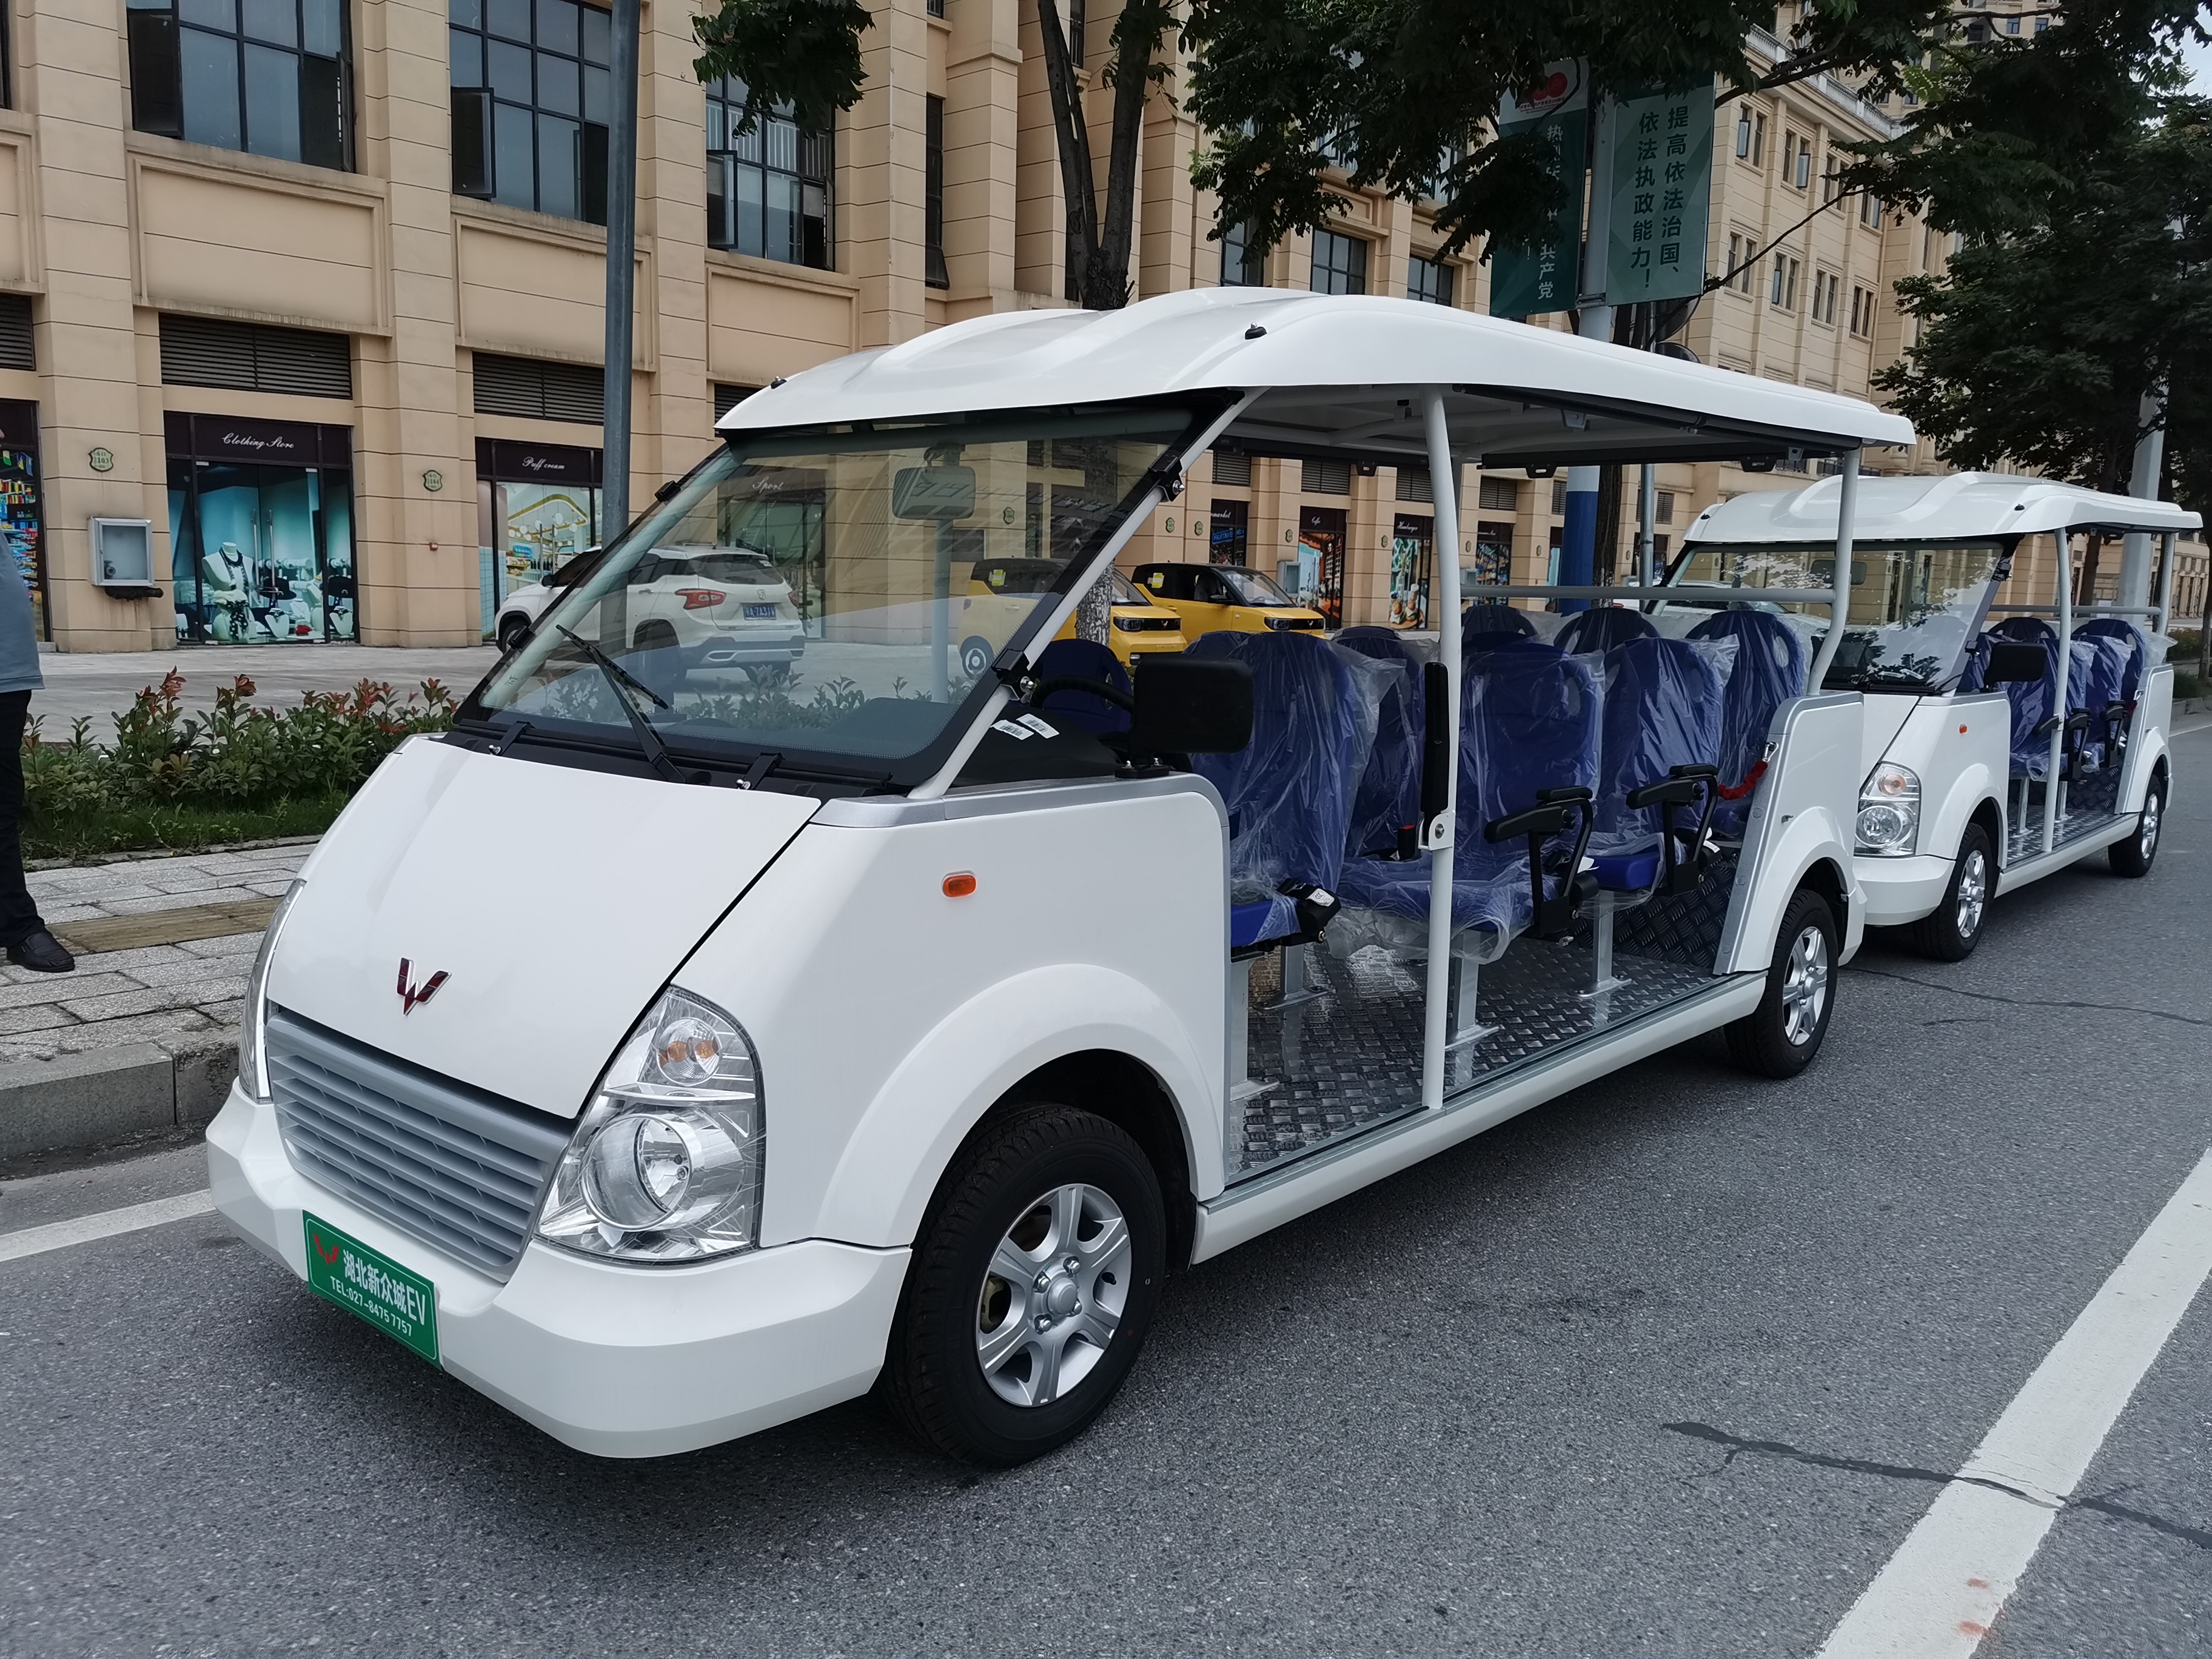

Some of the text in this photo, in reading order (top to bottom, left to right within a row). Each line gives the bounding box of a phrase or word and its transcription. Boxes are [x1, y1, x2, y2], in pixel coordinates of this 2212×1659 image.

[1660, 106, 1689, 273] 提高依法治国、
[222, 432, 295, 449] Clothing Store
[522, 457, 546, 471] Puff
[752, 476, 784, 493] Sport
[390, 1313, 412, 1337] 7757
